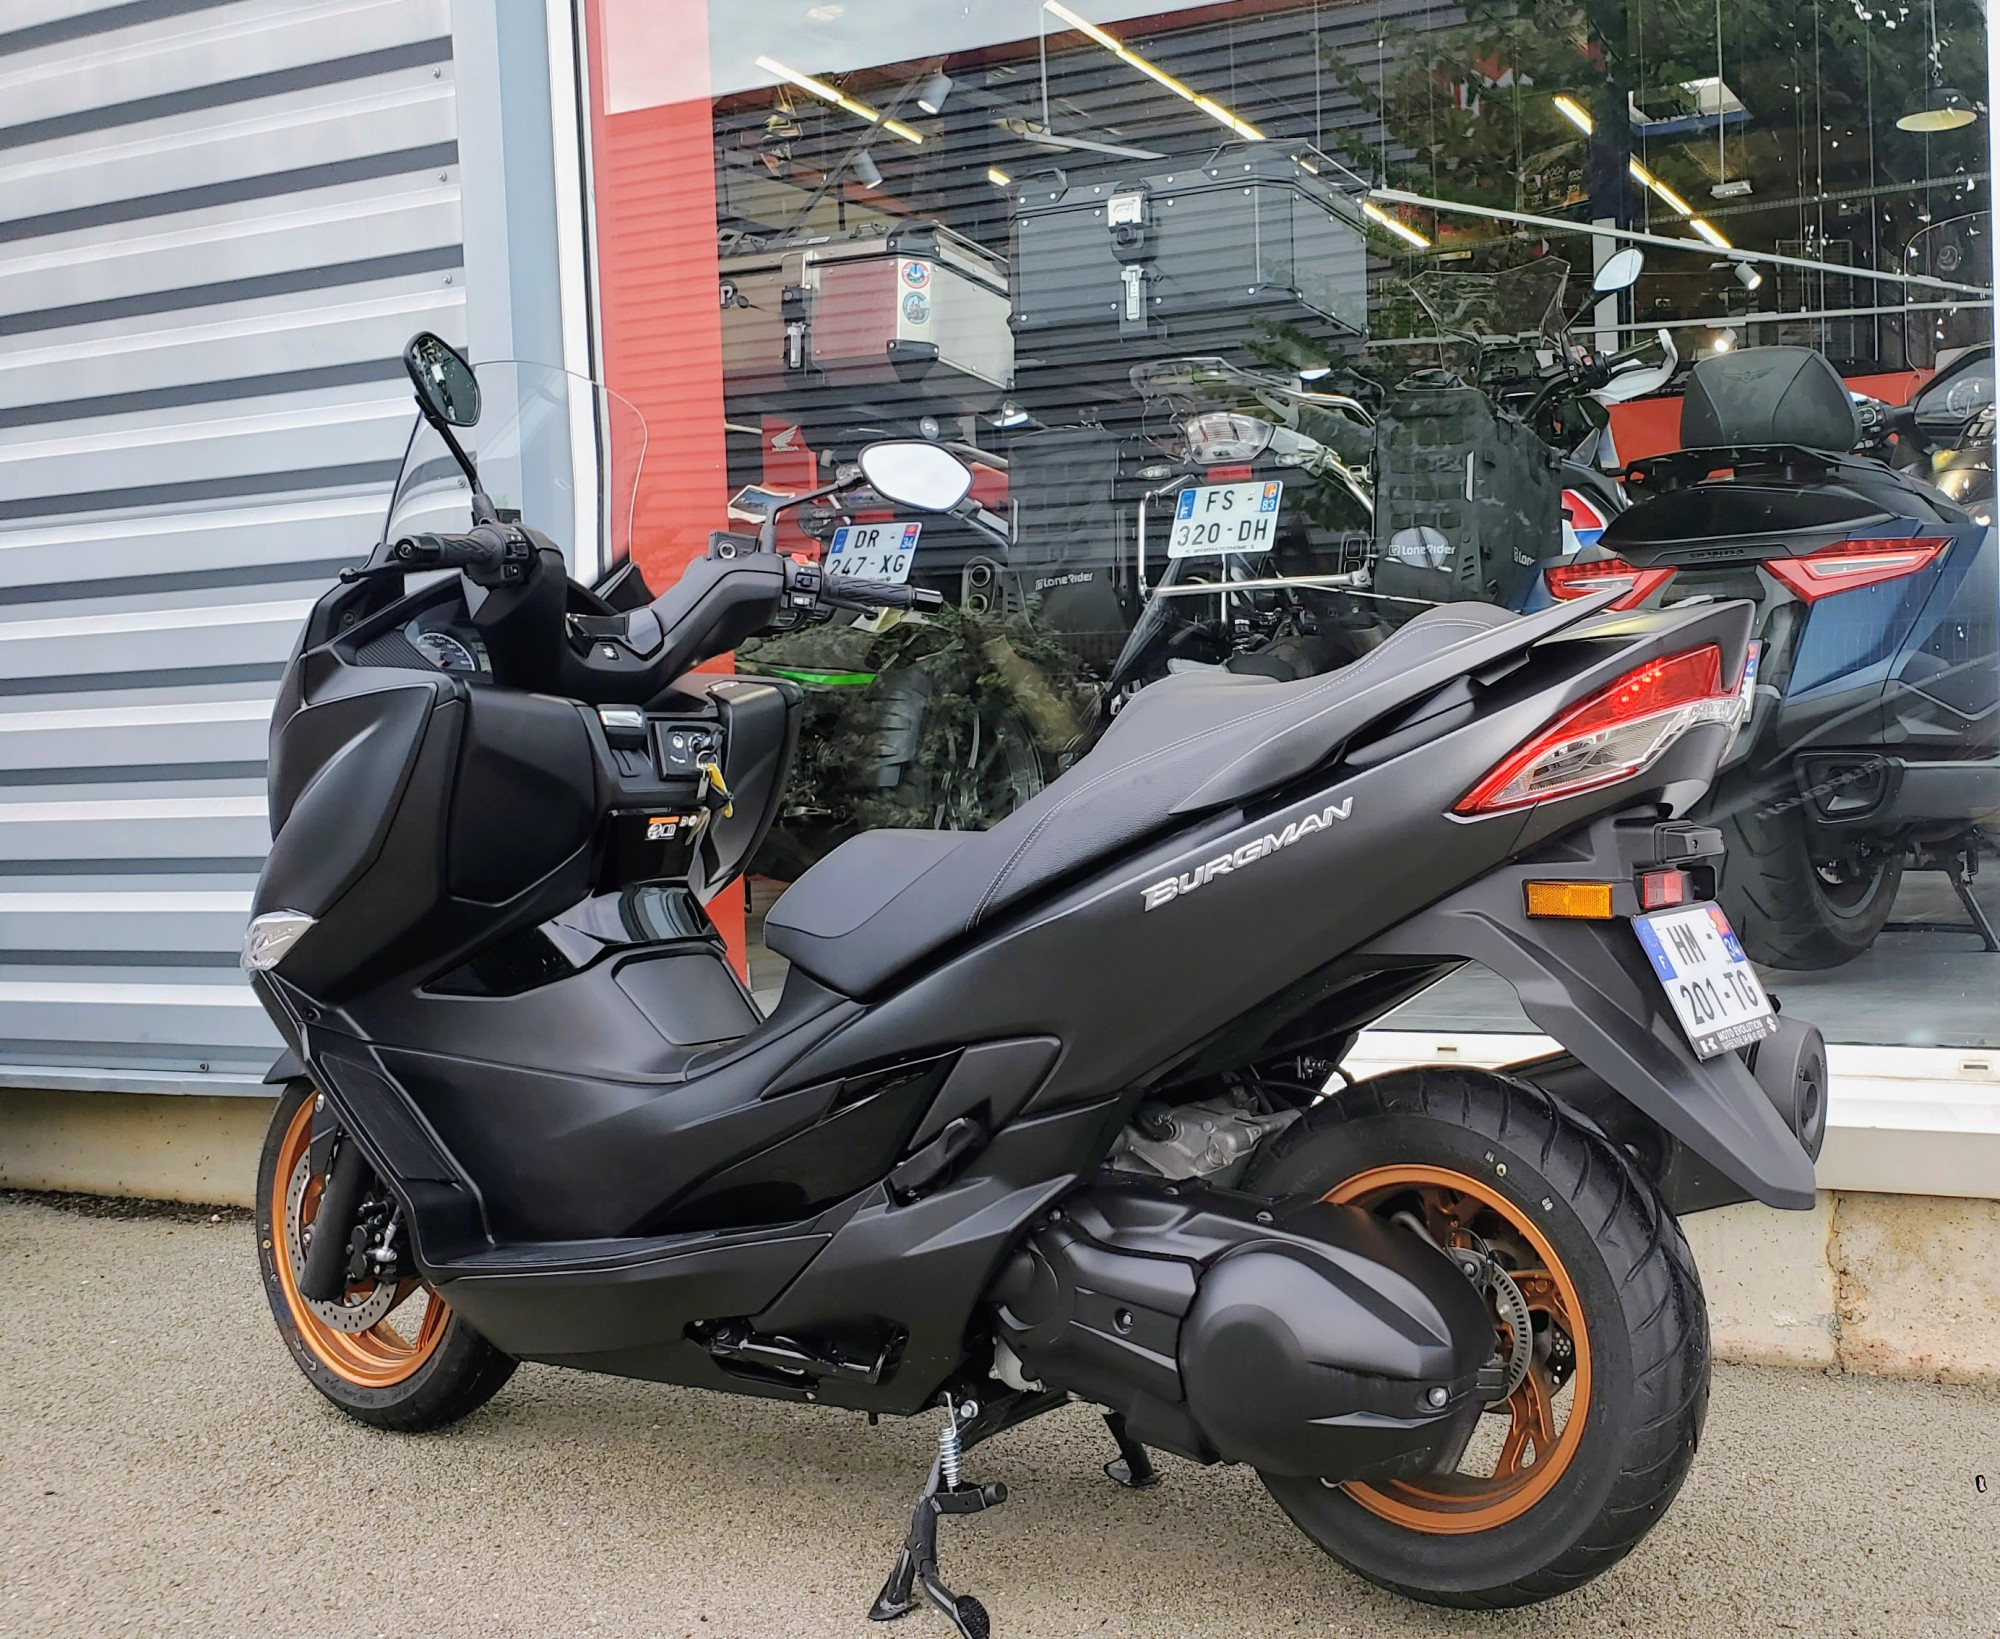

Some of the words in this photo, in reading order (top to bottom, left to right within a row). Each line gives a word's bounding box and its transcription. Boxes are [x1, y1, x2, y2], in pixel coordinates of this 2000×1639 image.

[772, 445, 799, 453] HONDA
[1206, 490, 1235, 512] FS
[1261, 500, 1275, 511] 83
[1180, 507, 1189, 518] F
[854, 529, 880, 548] DR
[901, 537, 913, 547] 34
[1177, 519, 1268, 546] 320-DH
[829, 555, 905, 576] 247-XG
[1141, 796, 1353, 912] BURGMAN
[1666, 923, 1706, 965] HM
[1723, 937, 1742, 957] 34
[1658, 955, 1666, 970] F
[1679, 969, 1759, 1026] 201-TG
